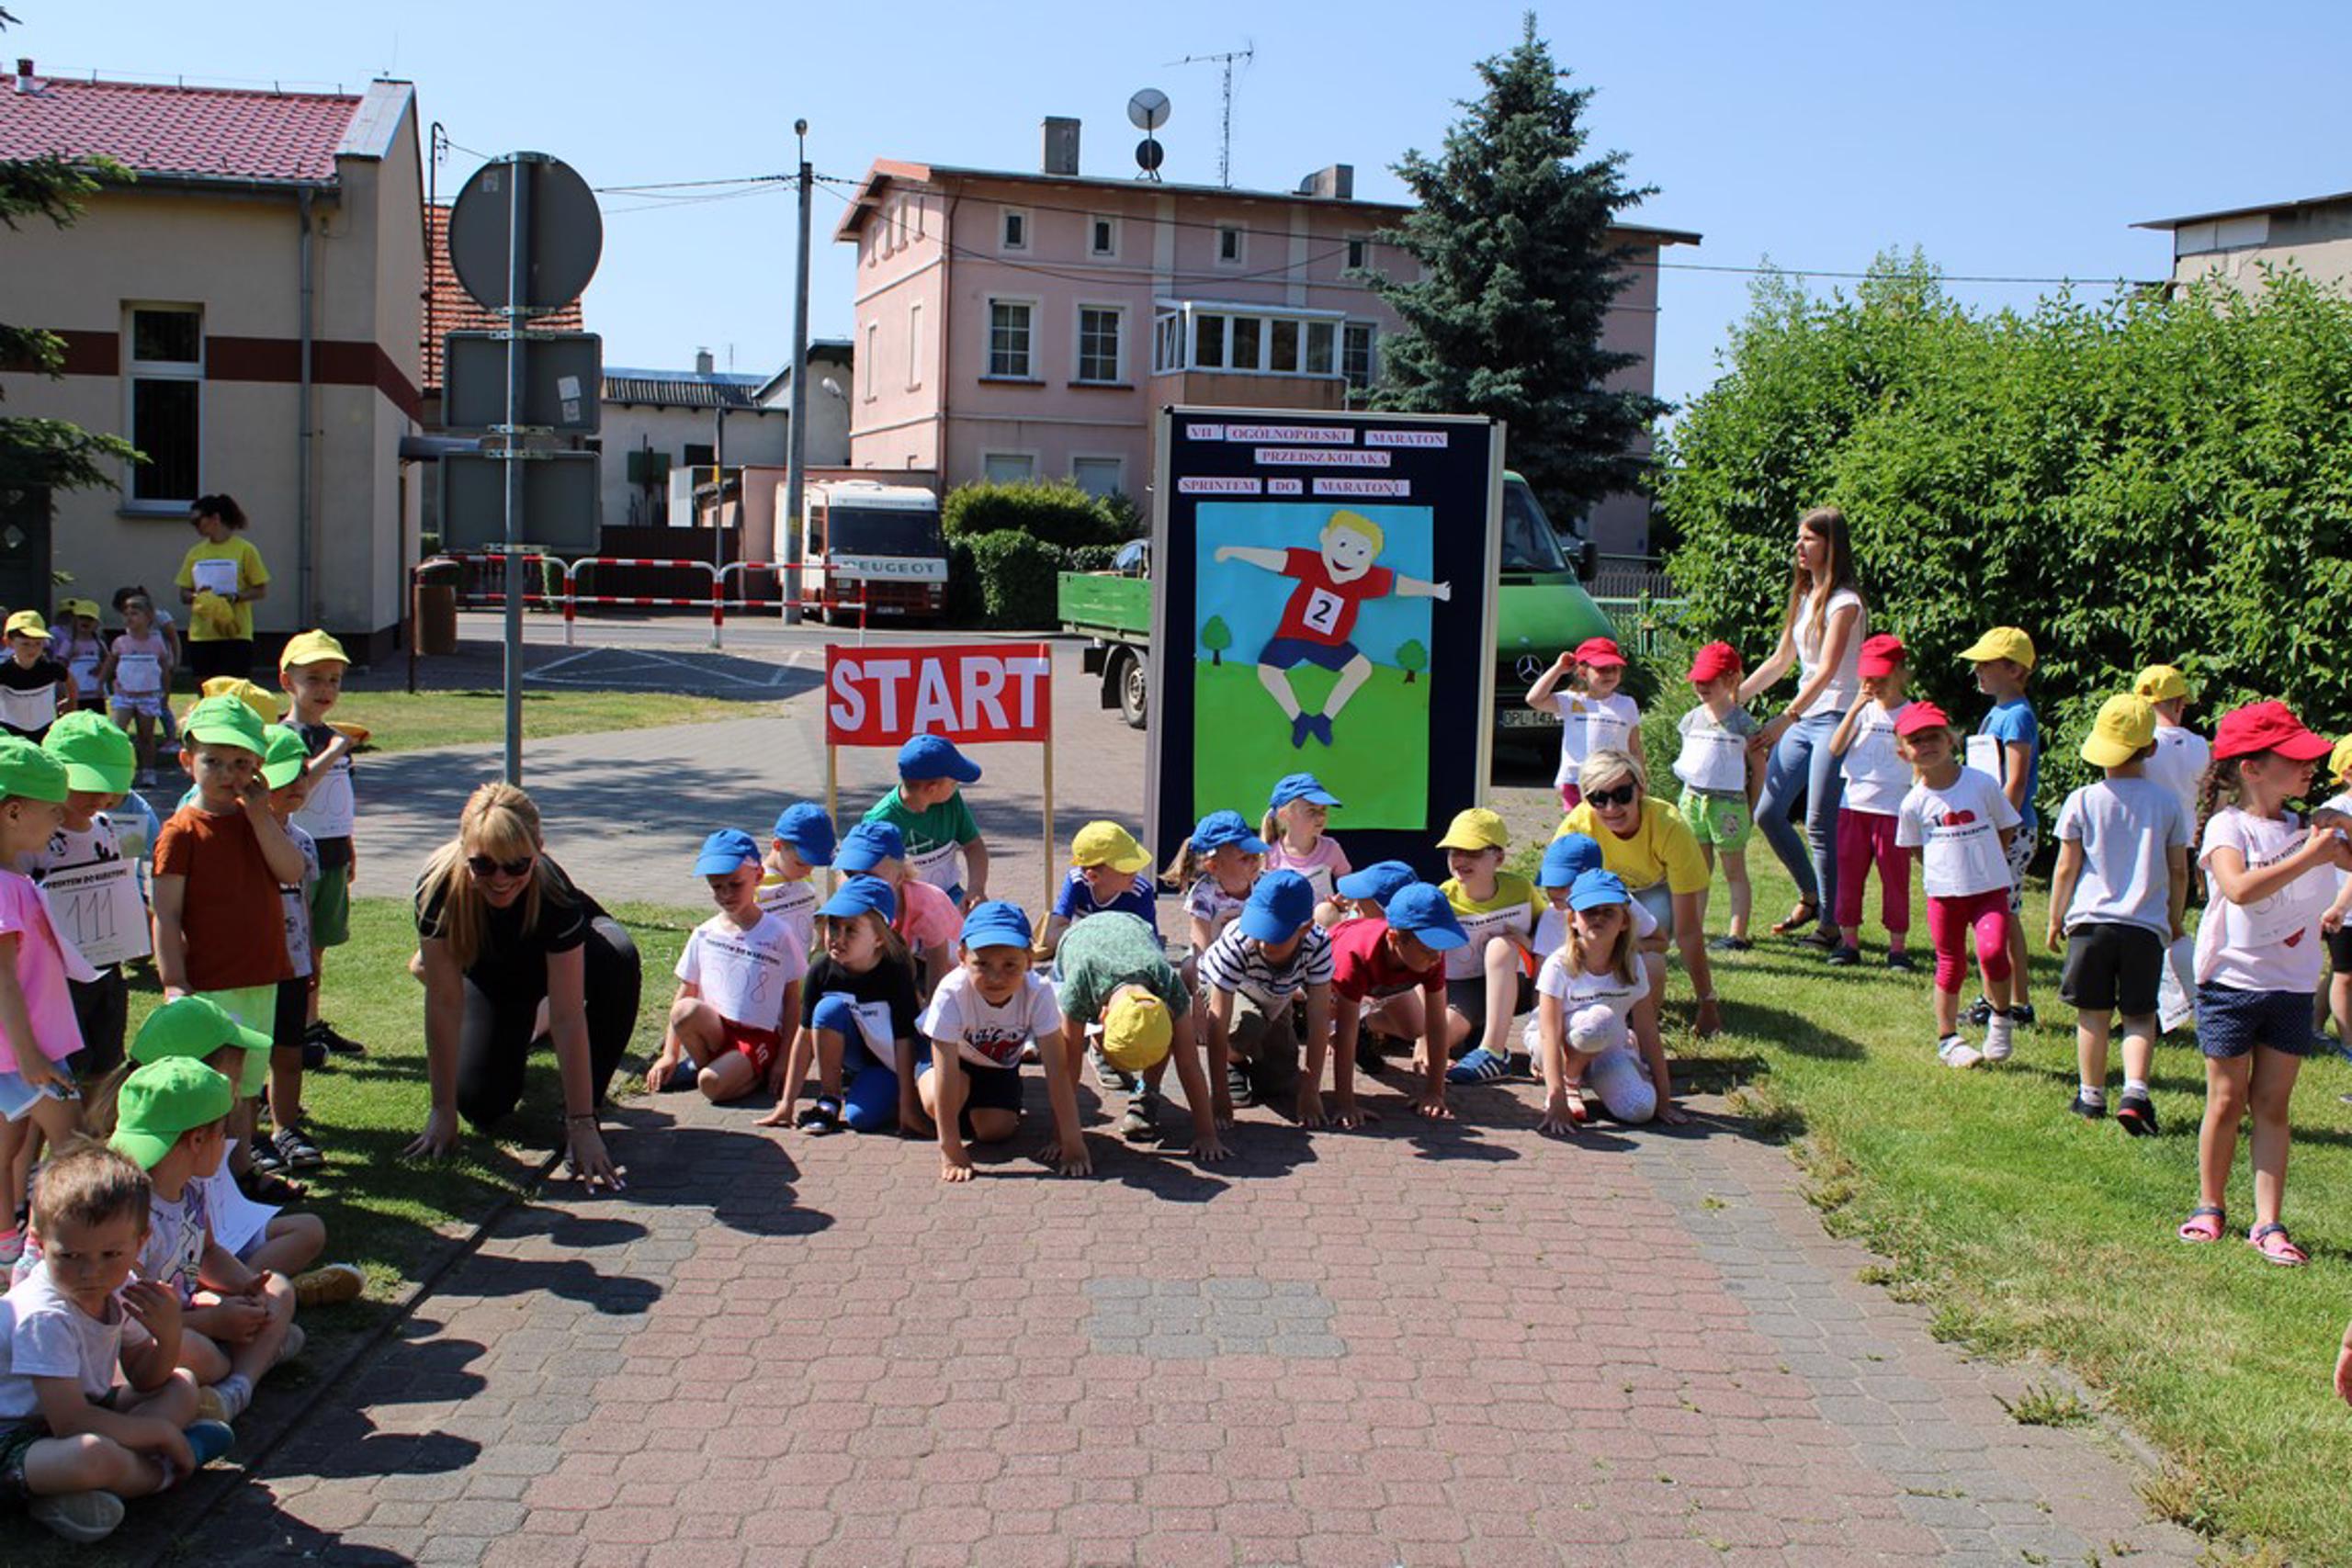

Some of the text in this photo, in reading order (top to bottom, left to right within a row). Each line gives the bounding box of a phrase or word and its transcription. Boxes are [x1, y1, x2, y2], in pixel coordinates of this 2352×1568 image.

[1372, 434, 1443, 445] MARATON
[1262, 451, 1387, 465] PRZEDSZKOLAKA
[1182, 480, 1403, 493] SPRINTEM DO MARATONU
[1312, 599, 1332, 624] 2
[830, 657, 1049, 734] START
[66, 887, 118, 945] 111
